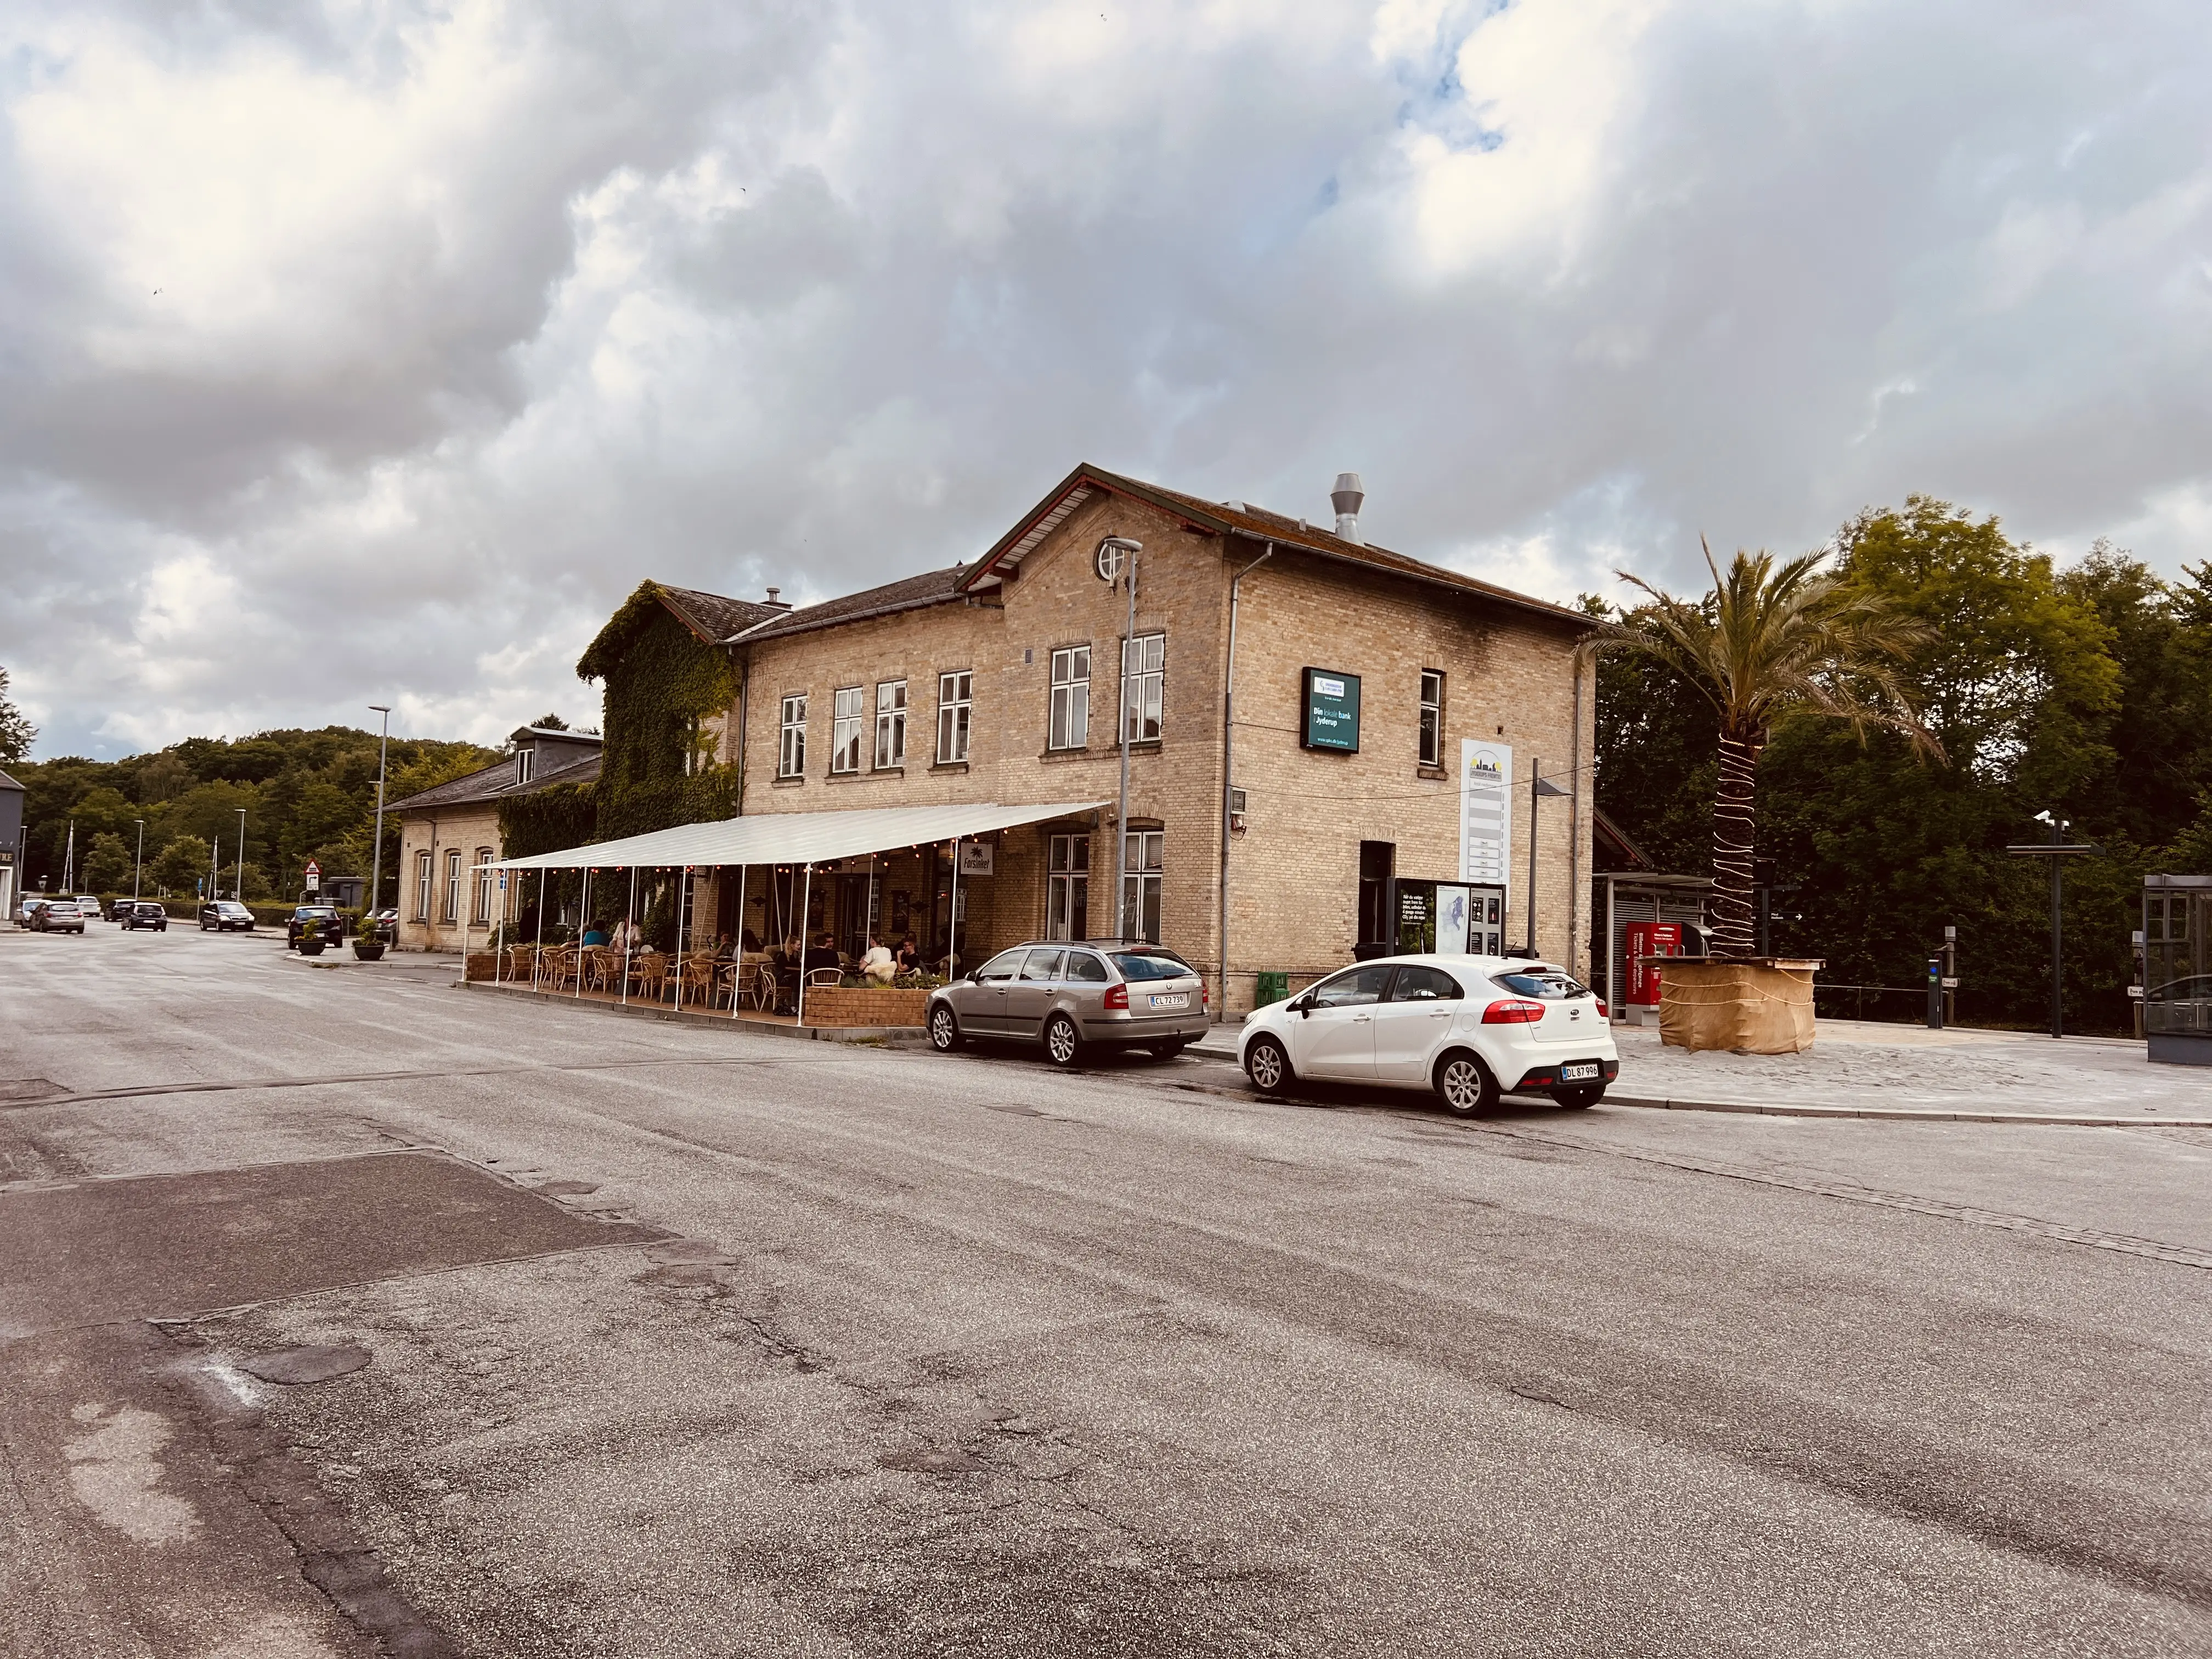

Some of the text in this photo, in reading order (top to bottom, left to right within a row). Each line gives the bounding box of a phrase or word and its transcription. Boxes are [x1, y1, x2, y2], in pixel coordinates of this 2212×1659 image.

[1314, 707, 1351, 720] Din lokale bank
[1316, 716, 1337, 727] Jyderup
[964, 857, 990, 870] Forsinket
[1567, 1066, 1597, 1077] DL 87 996
